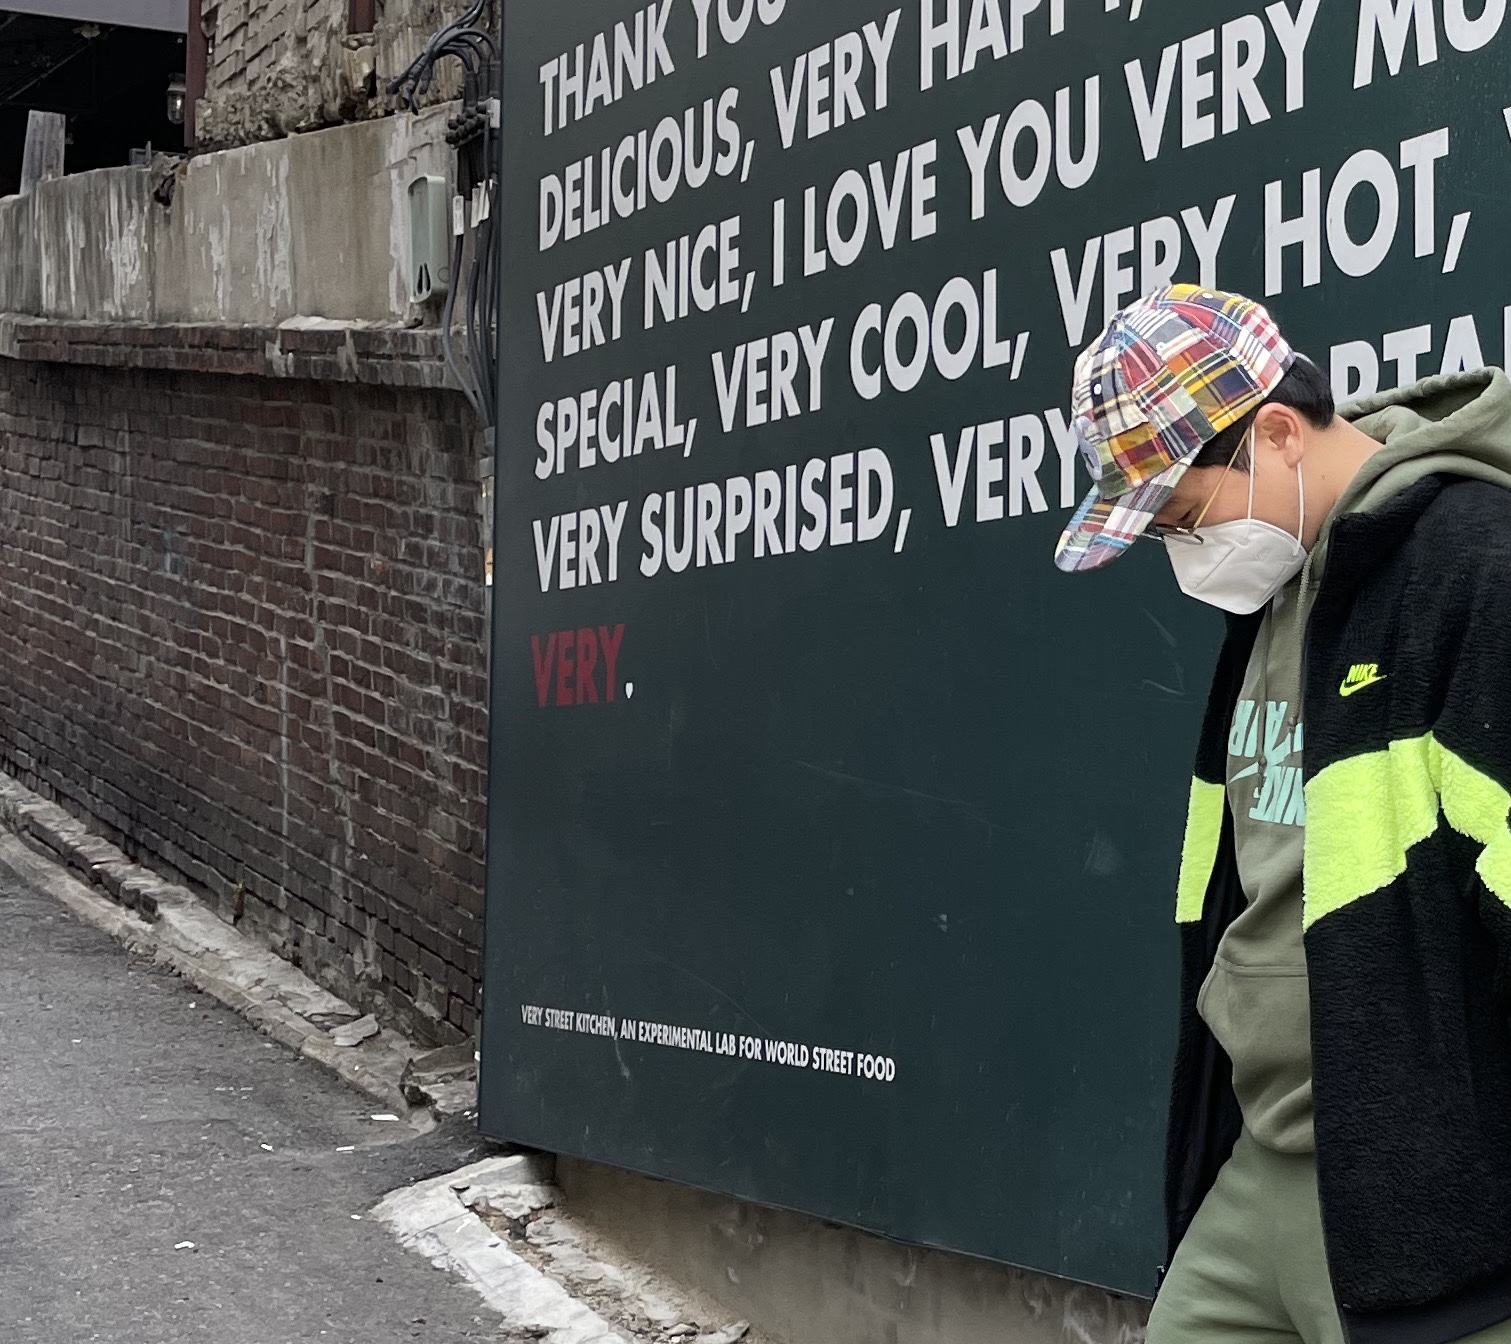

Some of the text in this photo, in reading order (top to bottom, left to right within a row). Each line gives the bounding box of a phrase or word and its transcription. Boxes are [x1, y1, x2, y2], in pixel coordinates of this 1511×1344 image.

[536, 257, 632, 363] VERY
[645, 215, 756, 330] NICE,
[772, 198, 786, 287] I
[804, 138, 937, 277] LOVE
[956, 74, 1100, 221] YOU
[540, 87, 755, 252] DELICIOUS,
[770, 7, 902, 150] VERY
[535, 364, 698, 480] SPECIAL,
[711, 303, 835, 433] VERY
[850, 268, 1030, 400] COOL,
[1050, 194, 1237, 348] VERY
[1264, 126, 1472, 298] HOT,
[532, 500, 629, 593] VERY
[639, 447, 912, 577] SURPRISED,
[929, 407, 1078, 528] VERY
[531, 624, 634, 707] VERY.
[1346, 663, 1379, 683] NIKE
[521, 1004, 896, 1083] VERY STREET KITCHEN, AN EXPERIMENTAL LAB FOR WORLD STREET FOOD
